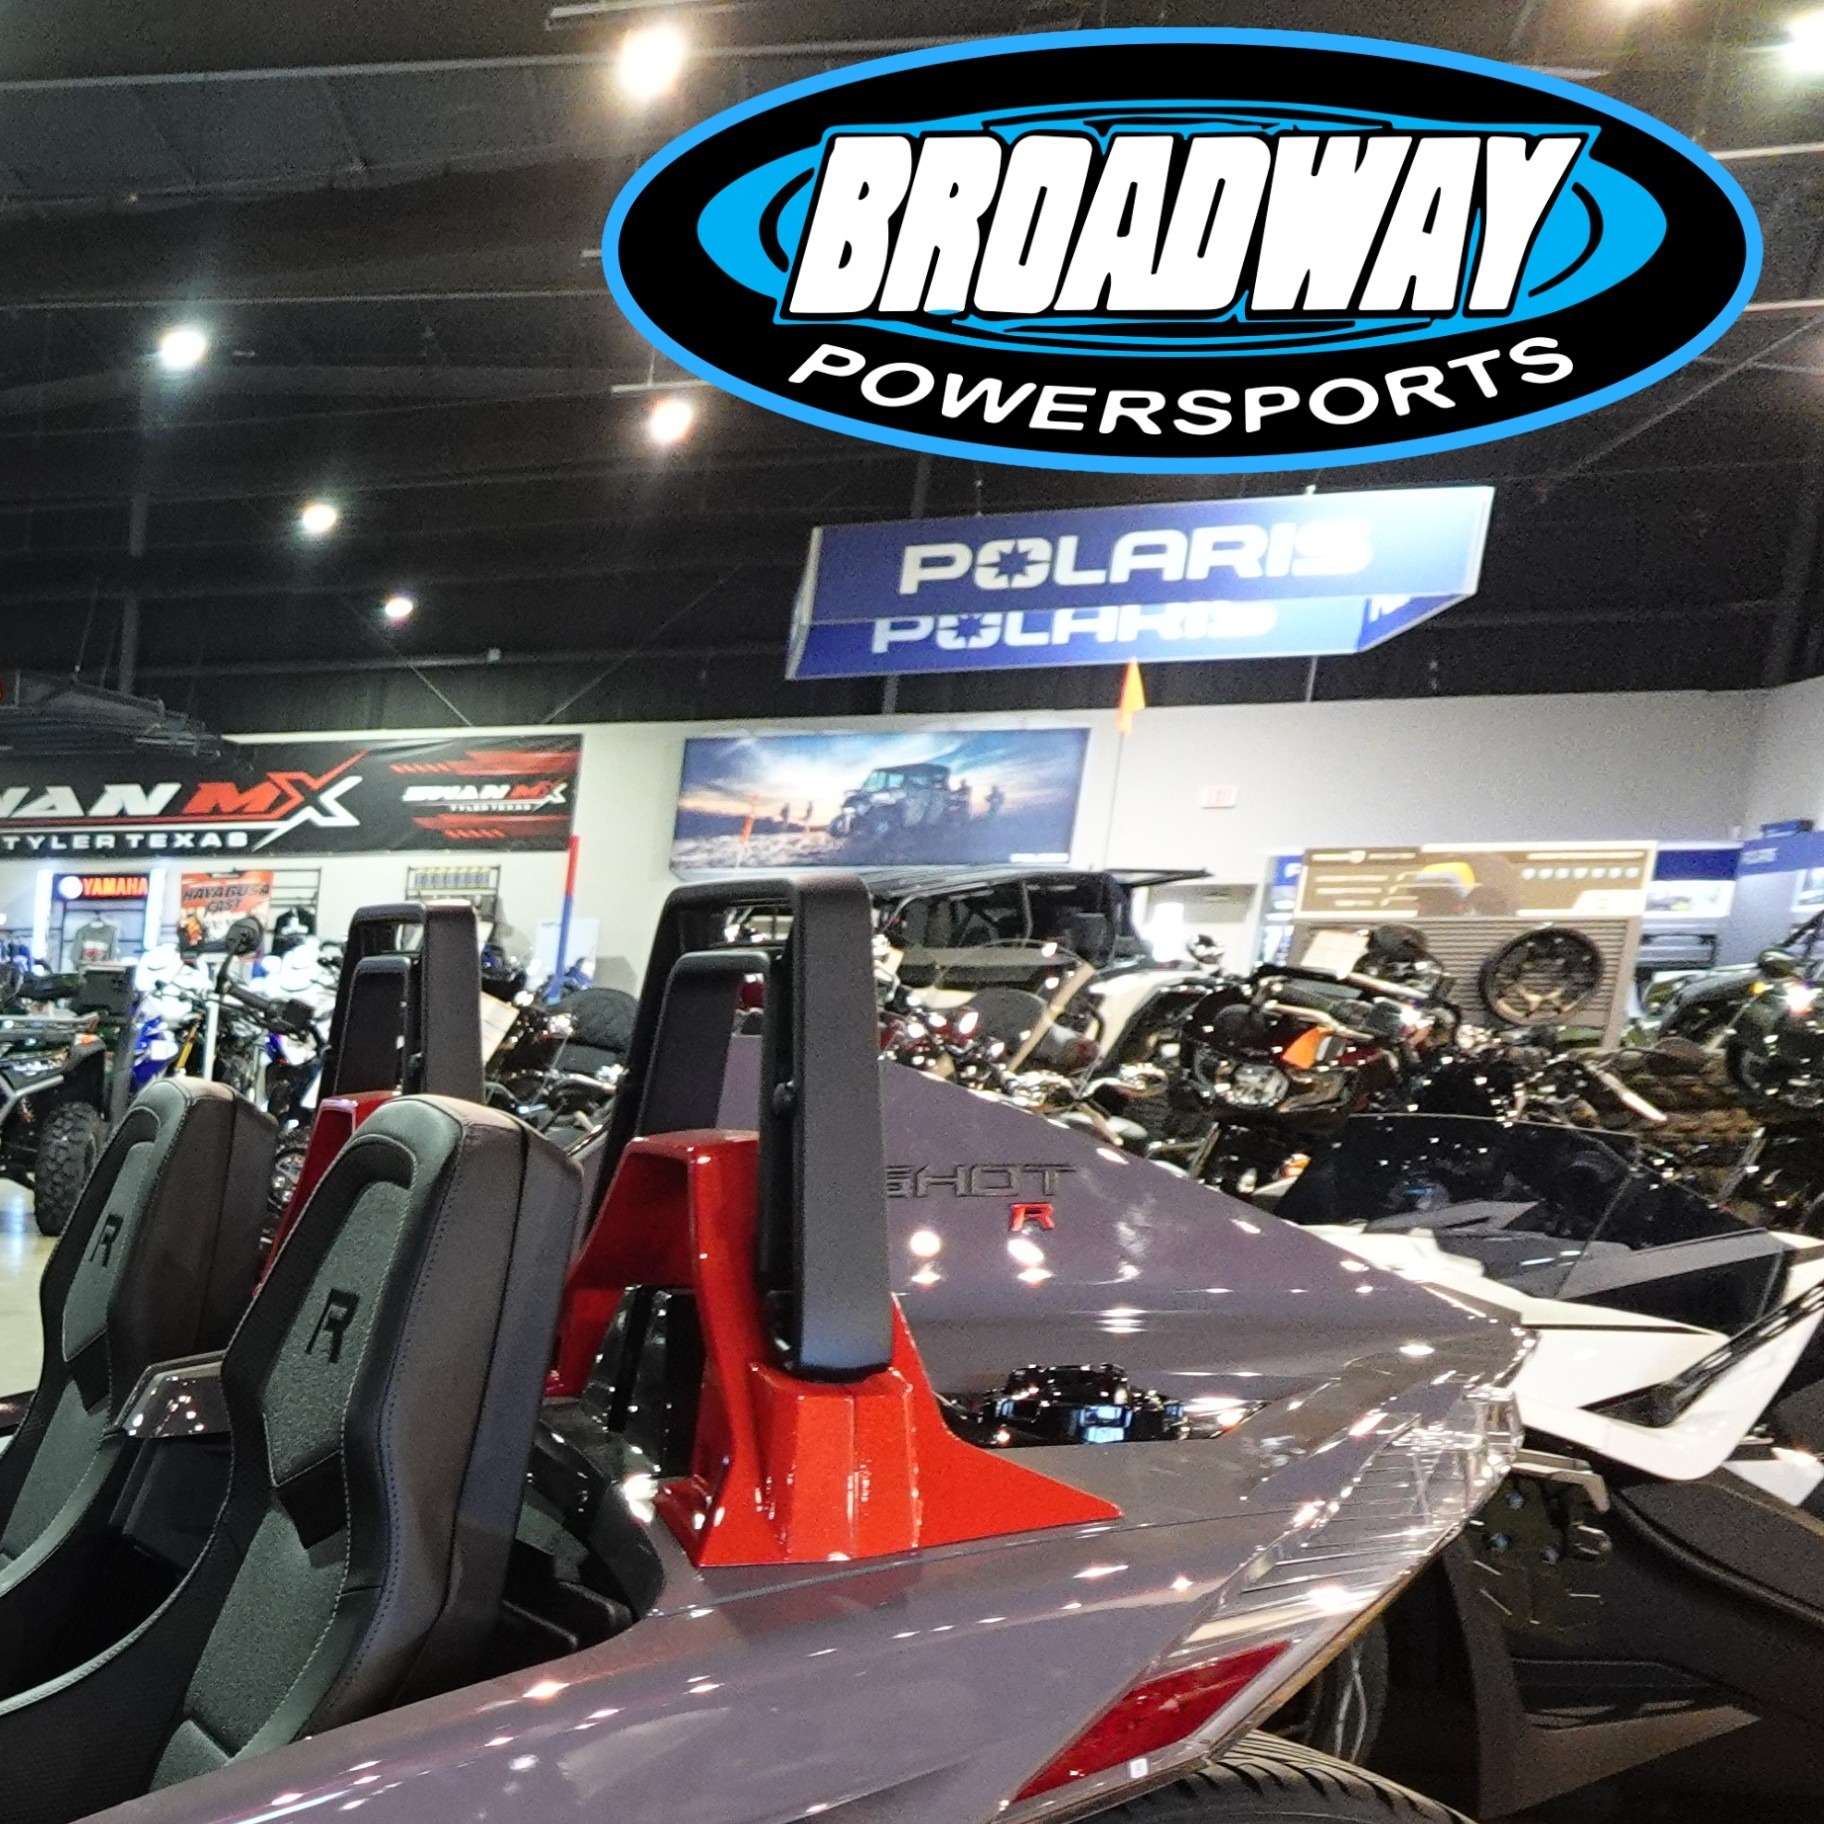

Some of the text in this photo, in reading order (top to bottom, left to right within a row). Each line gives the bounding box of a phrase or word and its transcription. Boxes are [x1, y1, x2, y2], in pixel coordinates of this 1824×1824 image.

[899, 520, 1373, 594] POLARIS
[182, 752, 368, 848] MX
[2, 831, 250, 850] TYLER TEXAS
[82, 877, 148, 896] YAMAHA
[89, 1213, 124, 1268] R
[1009, 1202, 1055, 1231] R
[305, 1287, 360, 1363] R
